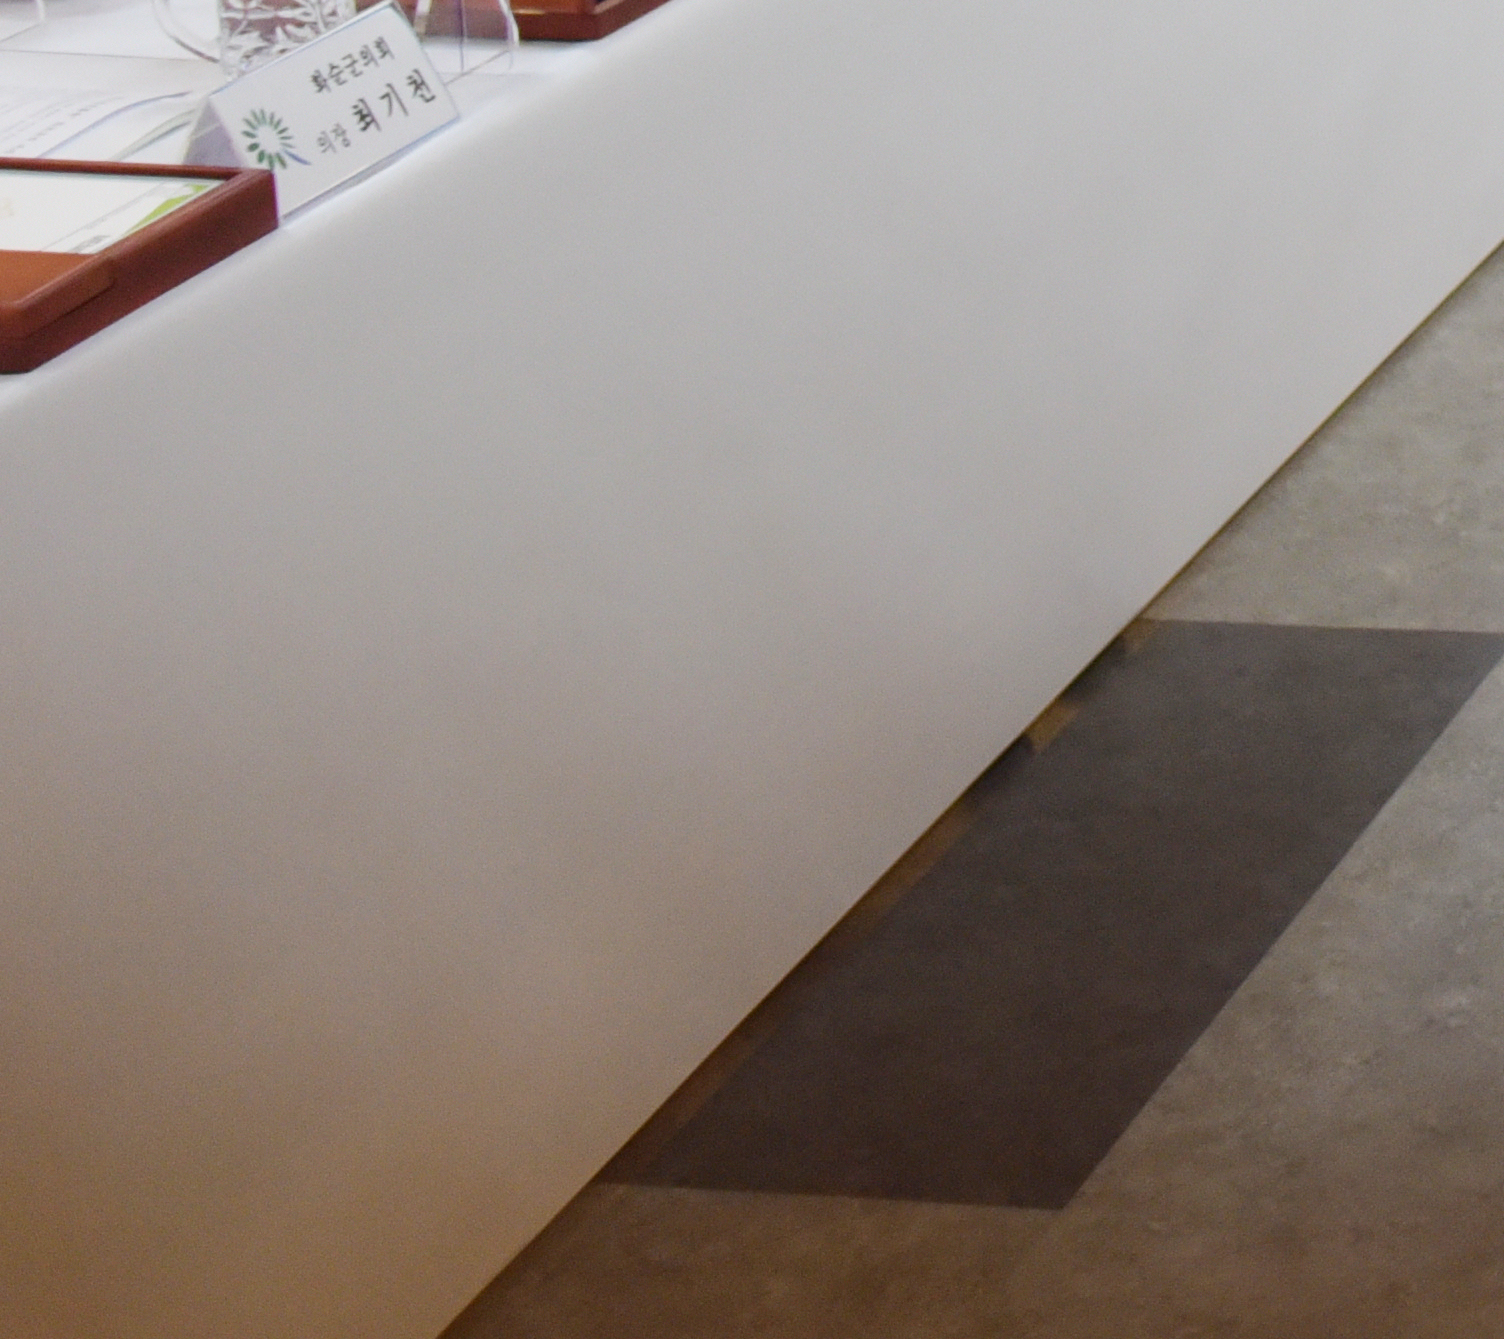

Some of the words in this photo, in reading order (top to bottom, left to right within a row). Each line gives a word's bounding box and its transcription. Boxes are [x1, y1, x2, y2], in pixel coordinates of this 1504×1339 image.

[310, 36, 395, 94] 화순군의회
[316, 122, 352, 155] 의장
[351, 68, 436, 132] 최기천
